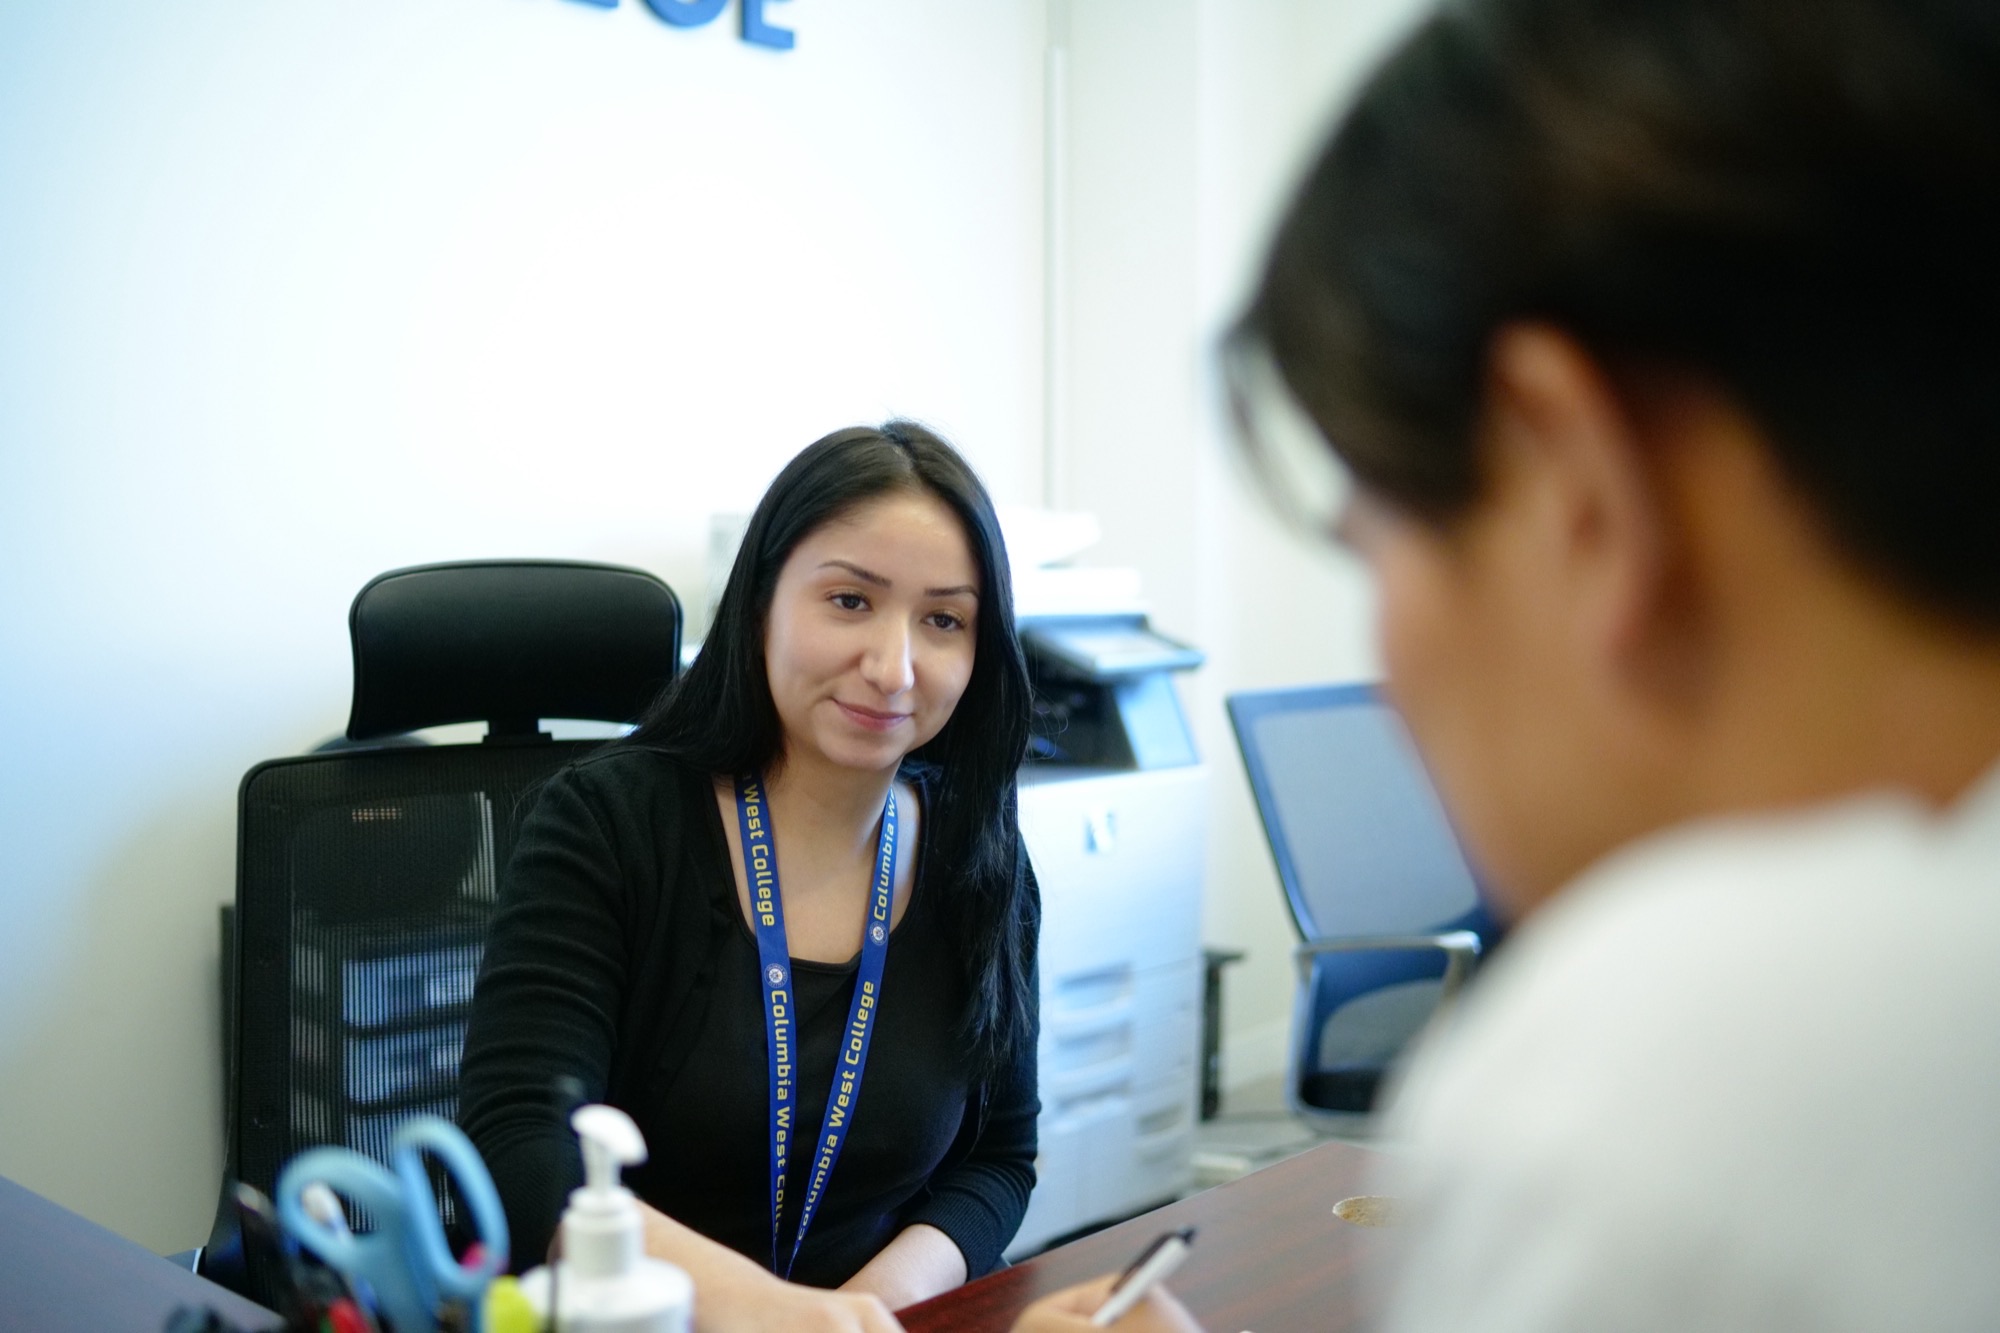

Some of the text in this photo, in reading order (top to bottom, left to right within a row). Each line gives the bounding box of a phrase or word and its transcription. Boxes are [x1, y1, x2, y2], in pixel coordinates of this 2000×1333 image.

[744, 783, 775, 926] West College
[873, 822, 895, 921] Columbia
[771, 990, 791, 1100] Columbia
[776, 1106, 790, 1168] West
[798, 981, 874, 1241] Columbia West College
